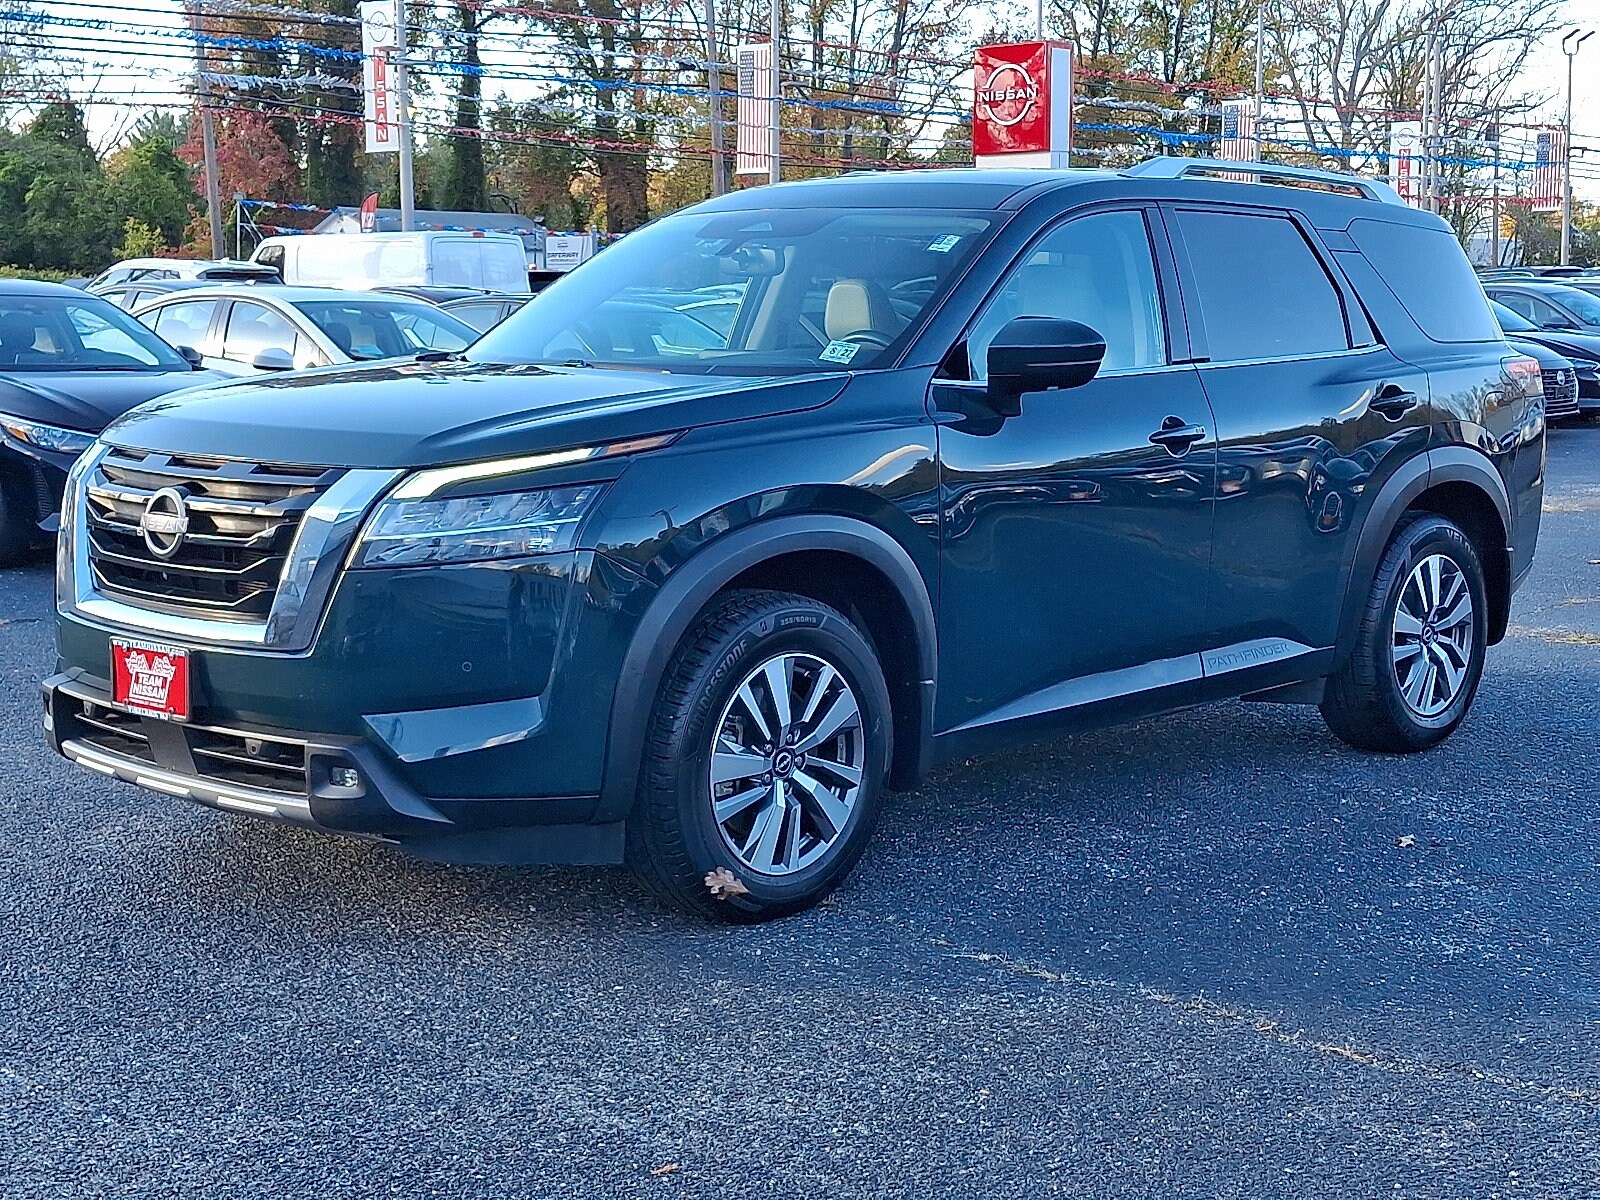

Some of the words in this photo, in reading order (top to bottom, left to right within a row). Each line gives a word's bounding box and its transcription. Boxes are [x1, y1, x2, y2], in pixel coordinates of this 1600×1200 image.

[374, 48, 388, 140] NISSAN
[979, 87, 1037, 102] NISSAN
[140, 514, 188, 532] NISSAN
[1207, 642, 1290, 669] PATHFINDER
[138, 672, 163, 690] TEAM
[132, 682, 166, 700] NISSAN
